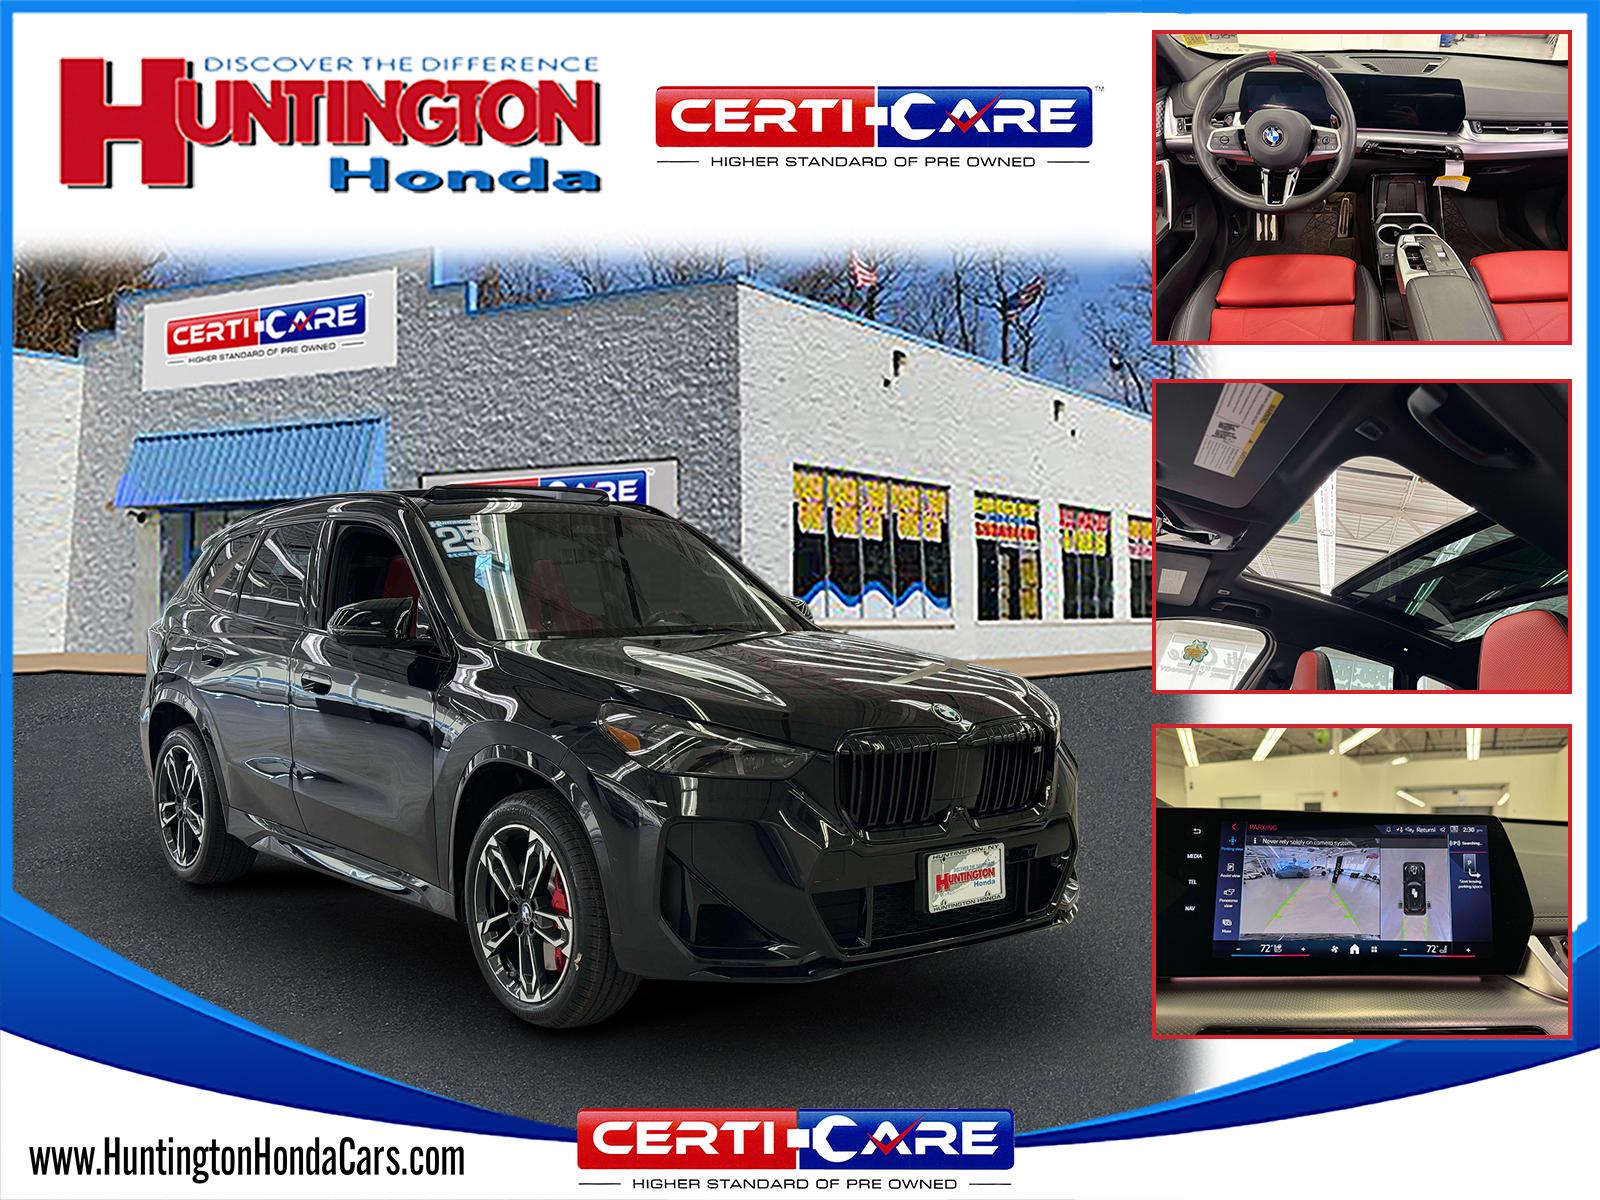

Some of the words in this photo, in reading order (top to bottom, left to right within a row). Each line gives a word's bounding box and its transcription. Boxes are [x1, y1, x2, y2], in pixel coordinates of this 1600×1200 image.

[188, 354, 218, 364] HIGHER
[219, 350, 265, 361] STANDARD
[266, 347, 279, 357] OF
[281, 345, 299, 355] PRE
[301, 342, 337, 352] OWNED
[435, 525, 492, 553] 25
[973, 878, 996, 888] Honda
[933, 899, 976, 912] HUNTINGTON
[977, 895, 1001, 903] HONDA
